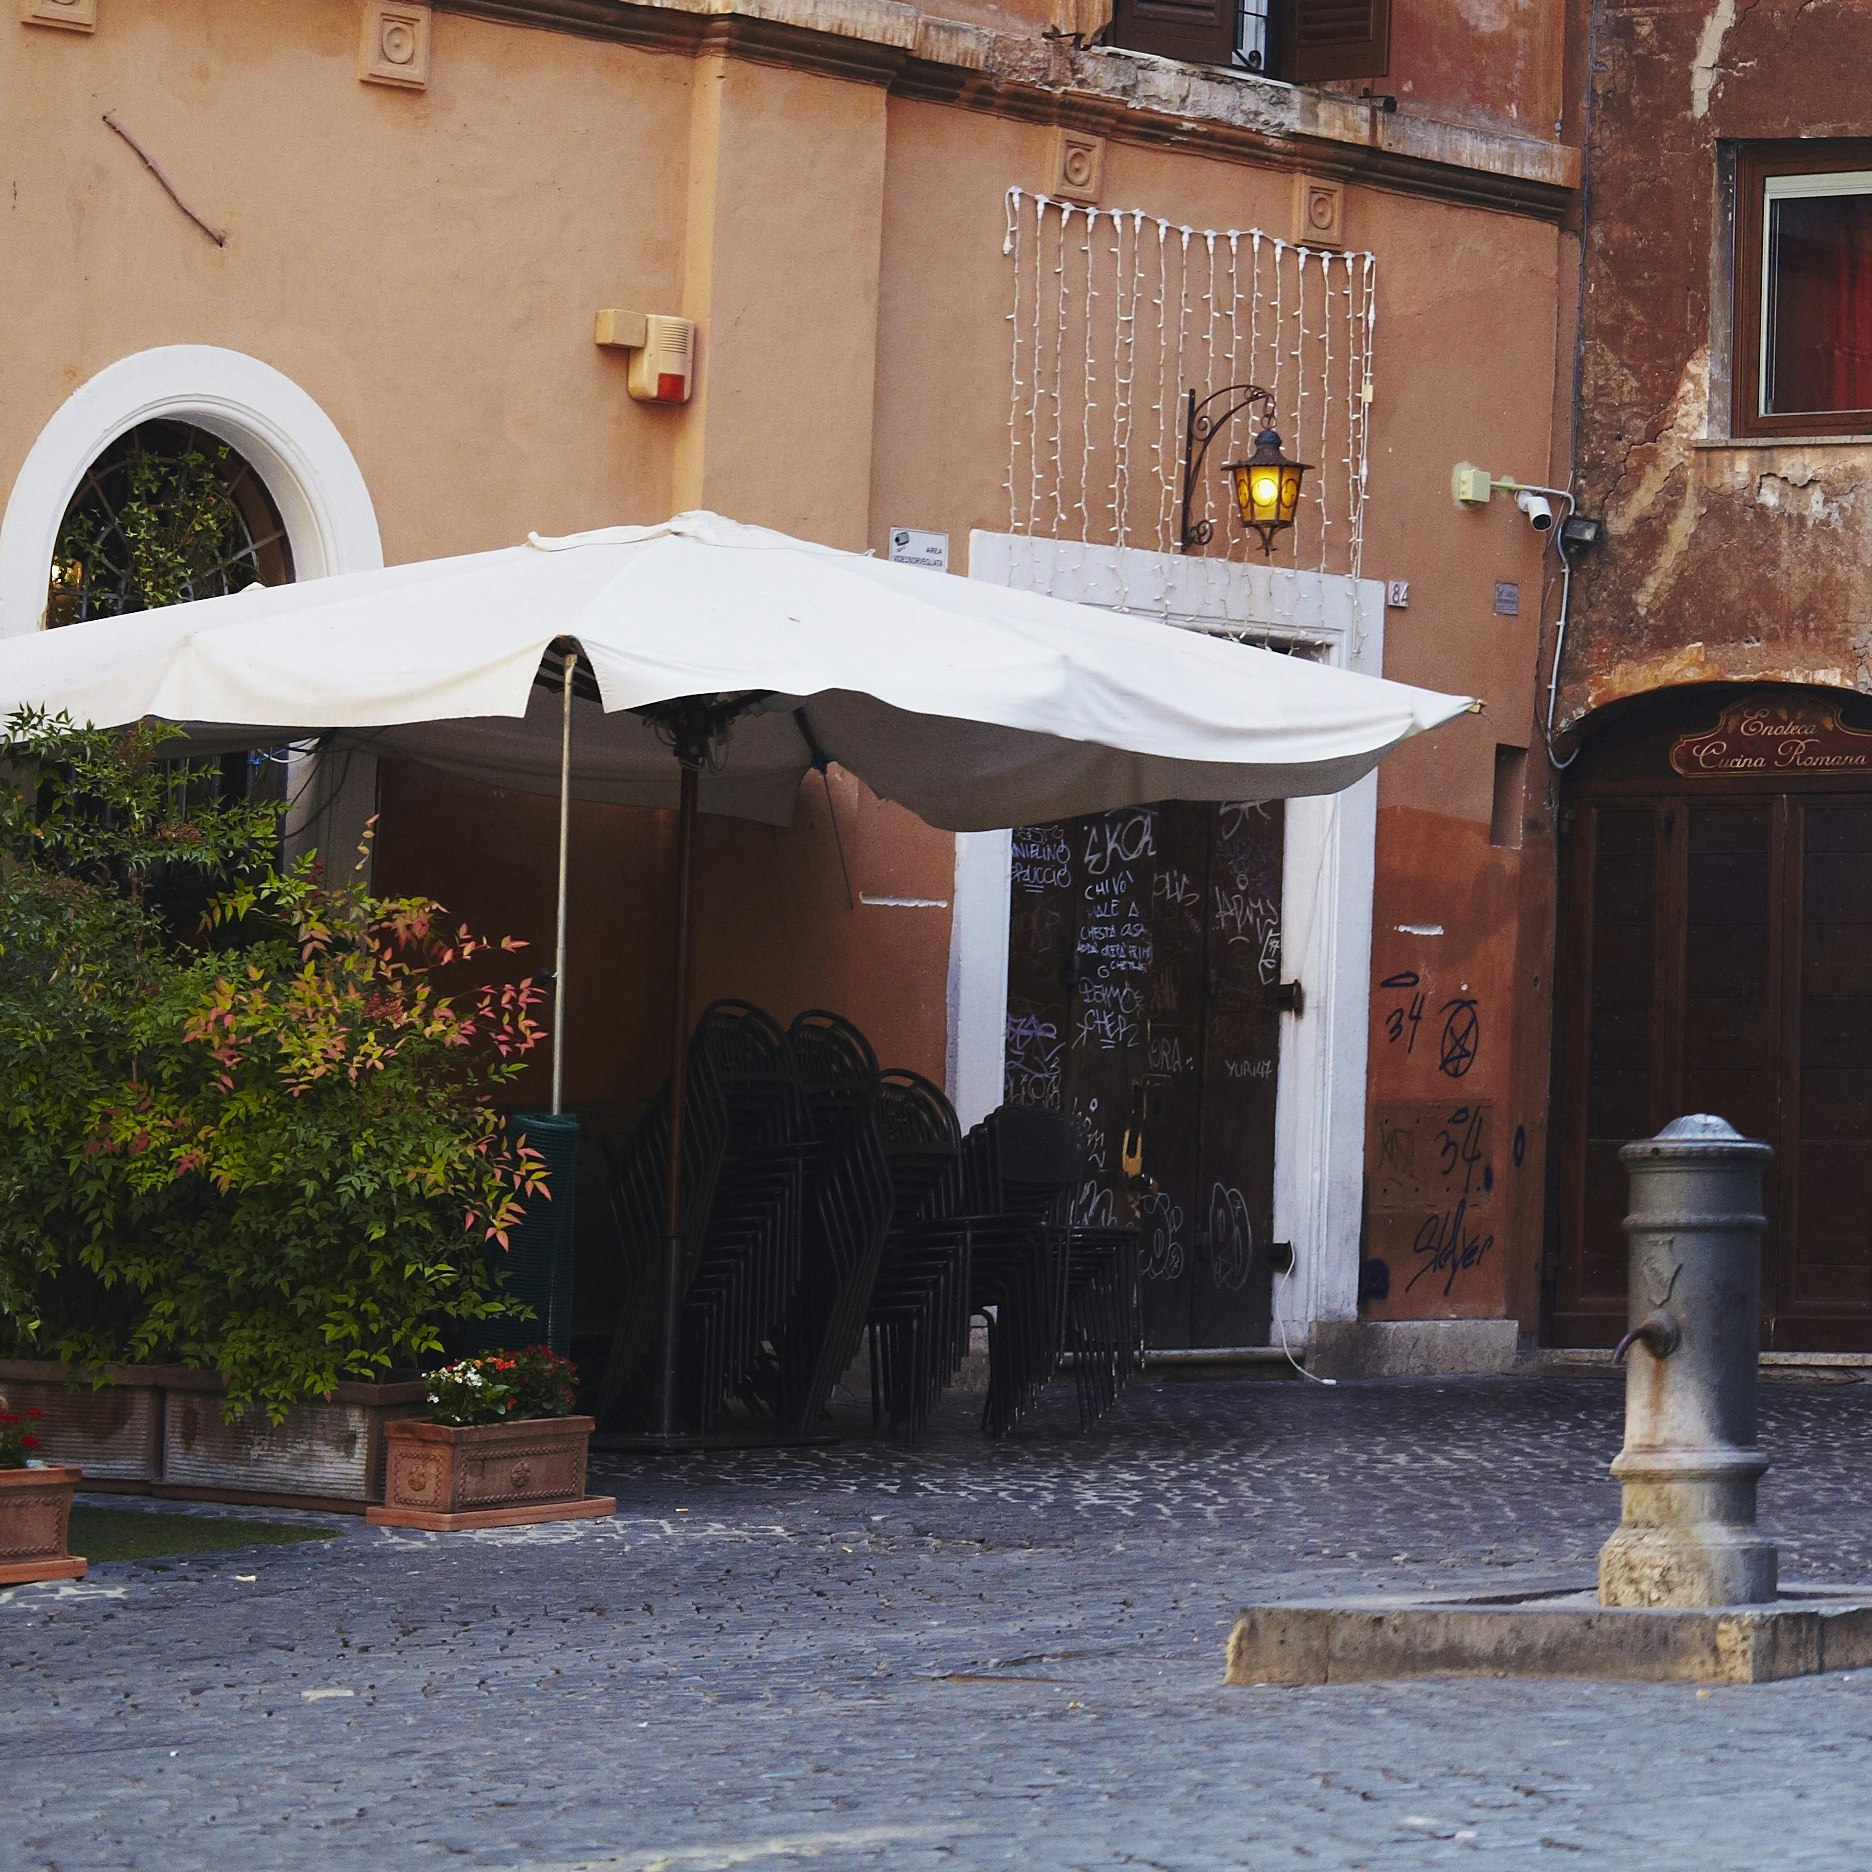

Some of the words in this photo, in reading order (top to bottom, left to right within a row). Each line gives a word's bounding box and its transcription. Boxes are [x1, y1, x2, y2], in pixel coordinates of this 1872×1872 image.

[926, 547, 942, 555] AREA
[1740, 708, 1817, 737] Enoteca
[1692, 740, 1766, 769] Cucina
[1774, 739, 1868, 768] Romana
